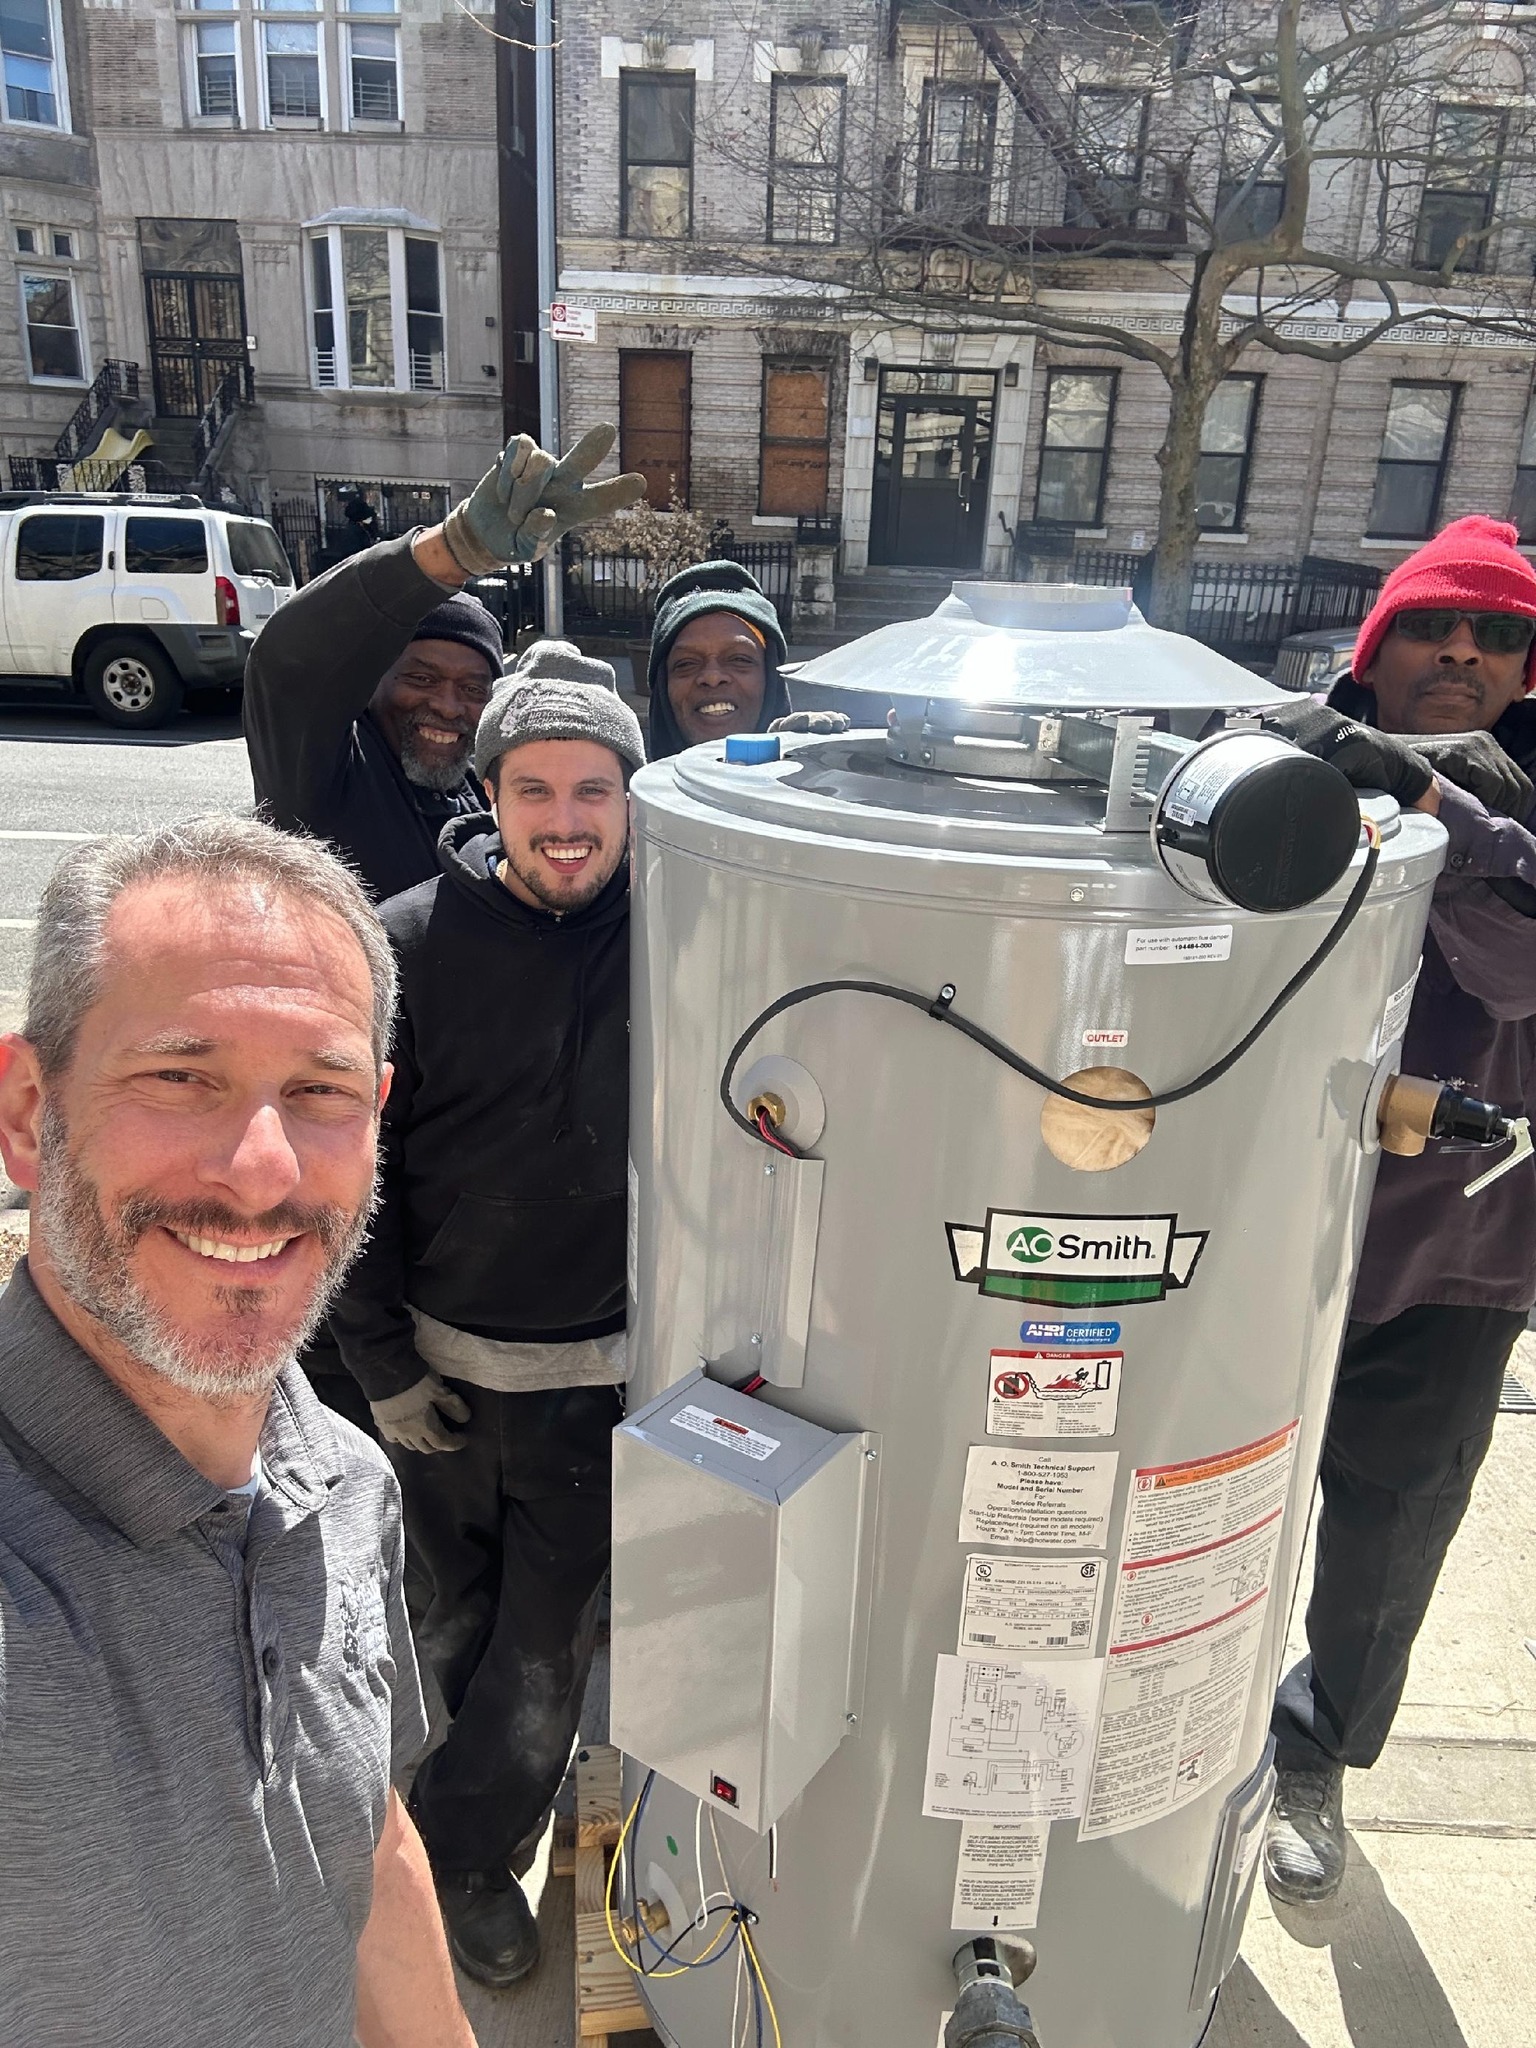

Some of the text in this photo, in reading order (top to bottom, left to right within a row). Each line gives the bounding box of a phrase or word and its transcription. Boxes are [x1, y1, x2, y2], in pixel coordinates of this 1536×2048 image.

[1087, 1034, 1124, 1042] OUTLET
[1026, 1324, 1112, 1338] AHRI CERTIFIED
[1011, 1462, 1031, 1470] Smith
